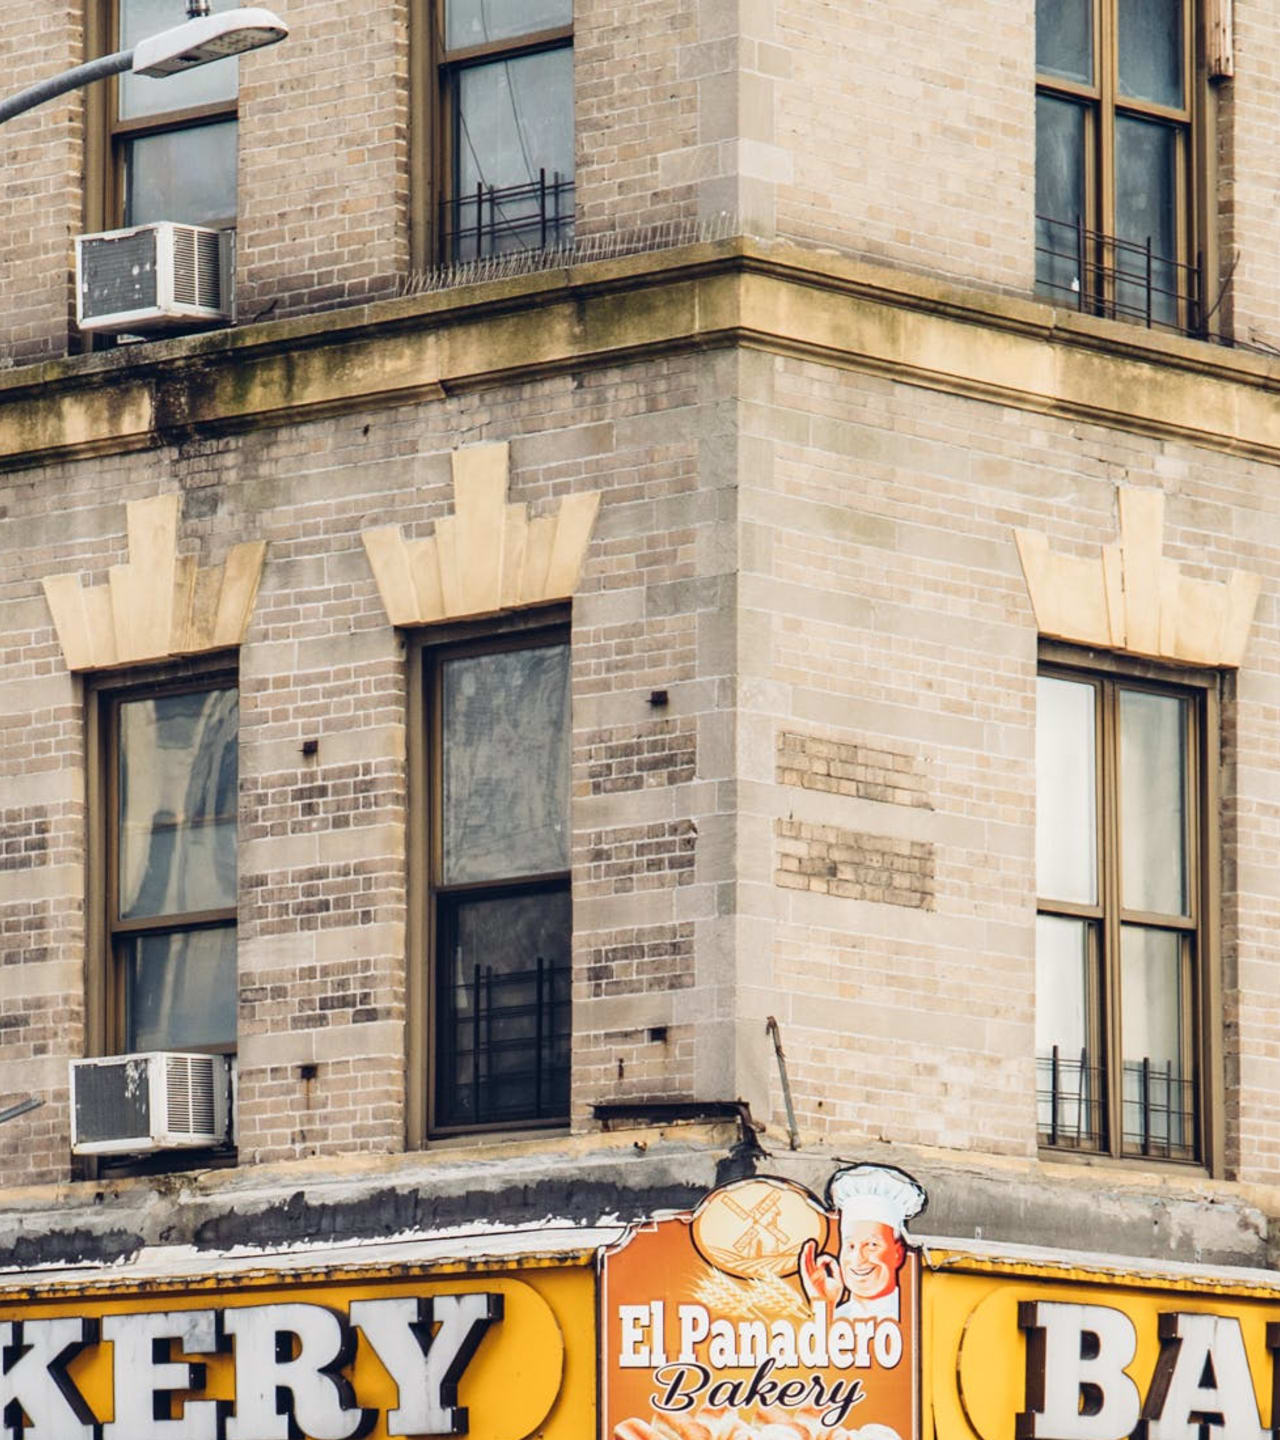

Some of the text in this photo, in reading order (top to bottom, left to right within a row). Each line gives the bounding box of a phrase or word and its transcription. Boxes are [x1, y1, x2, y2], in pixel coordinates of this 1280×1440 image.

[618, 1299, 904, 1370] El Panadero
[650, 1356, 865, 1428] Bakery
